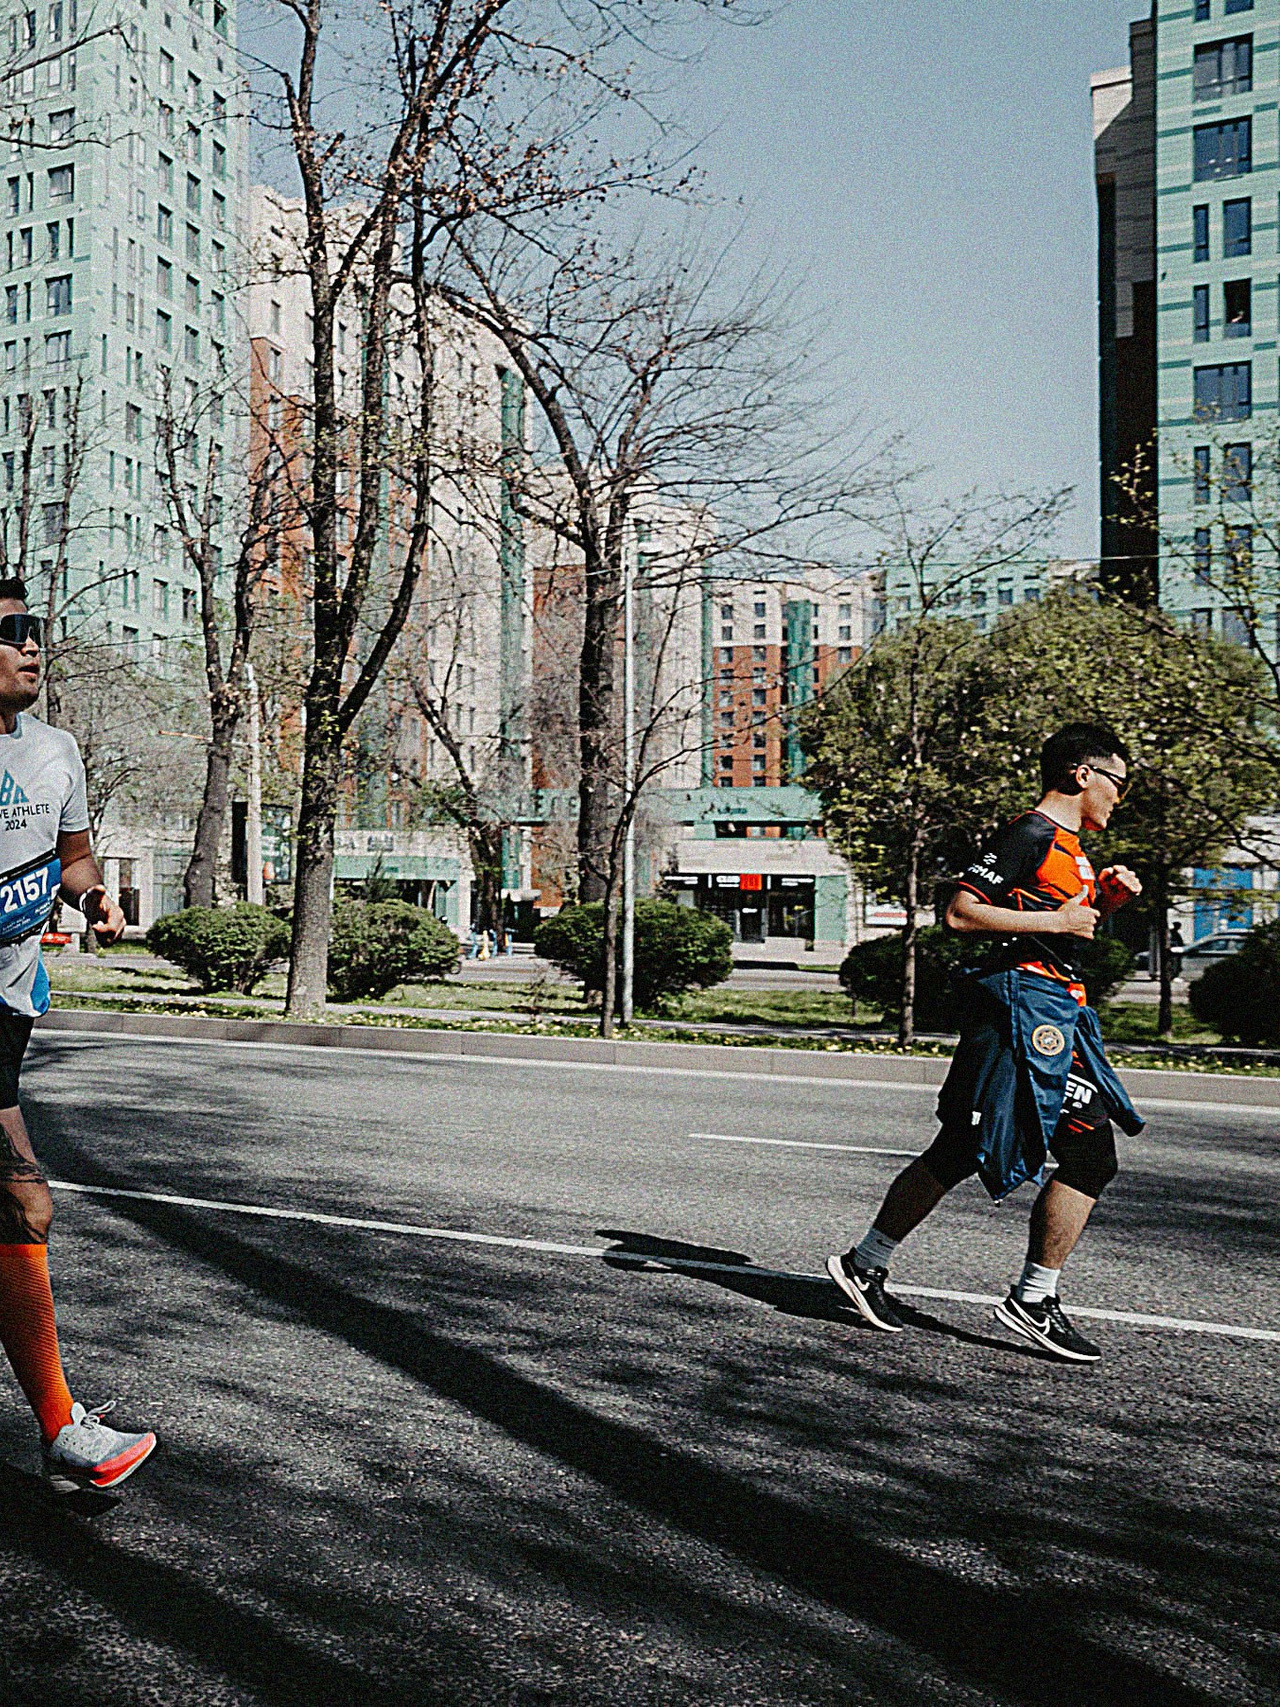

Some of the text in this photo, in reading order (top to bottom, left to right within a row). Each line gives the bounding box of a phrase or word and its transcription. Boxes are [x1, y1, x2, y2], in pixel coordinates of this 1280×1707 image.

[11, 803, 51, 818] ATHLETE
[5, 818, 27, 832] 2024
[0, 866, 48, 914] 2157
